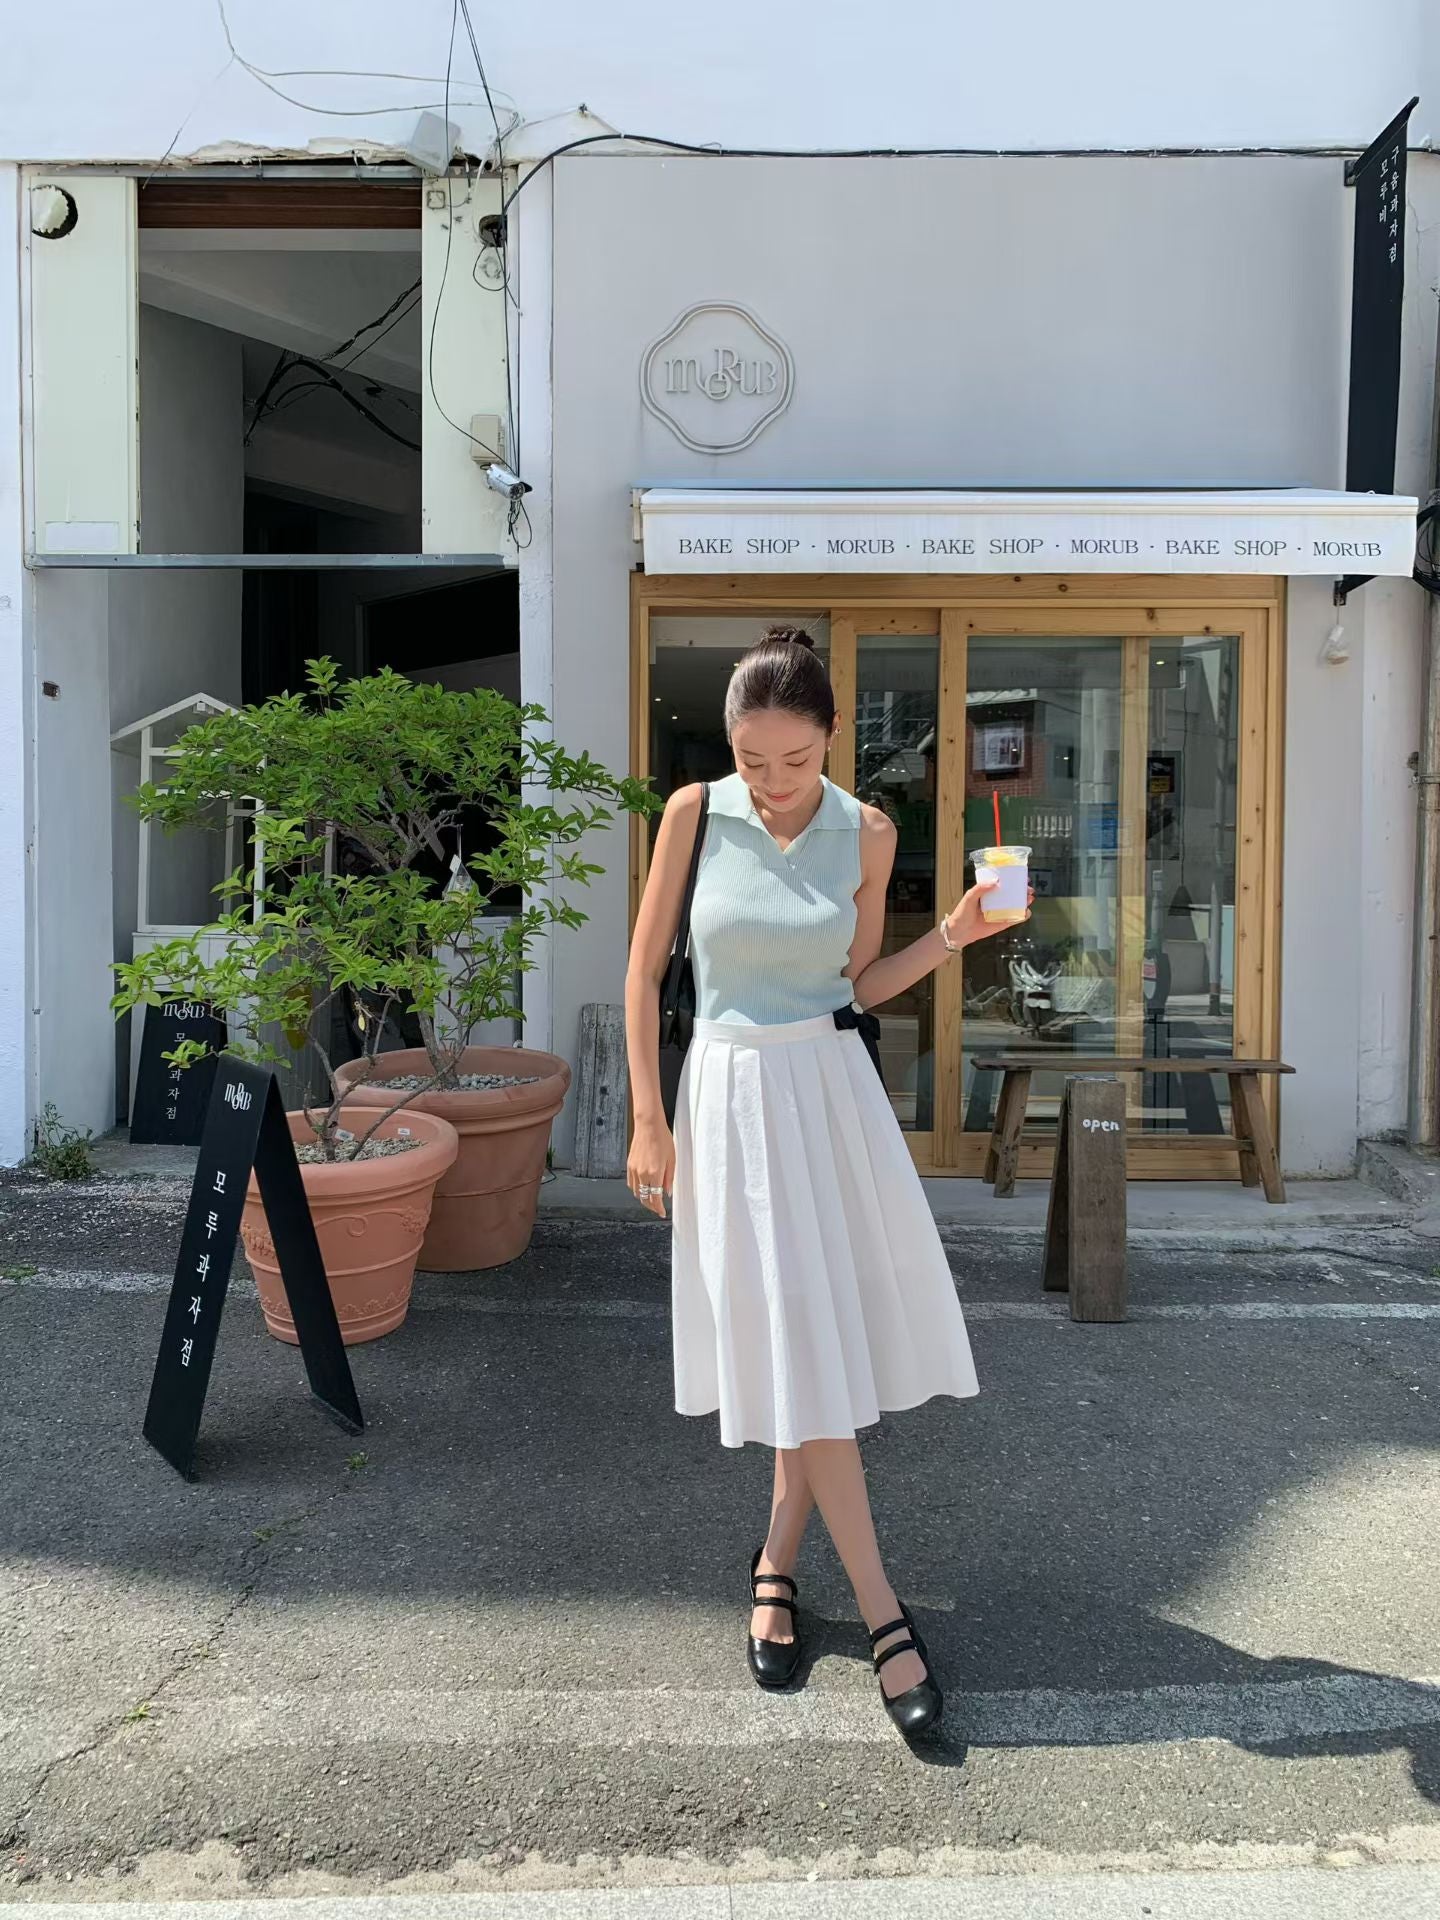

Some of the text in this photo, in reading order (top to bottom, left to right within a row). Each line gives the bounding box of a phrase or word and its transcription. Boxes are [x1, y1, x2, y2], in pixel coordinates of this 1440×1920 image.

[1388, 145, 1400, 264] 구움과자점
[679, 538, 1382, 557] BAKE SHOP MORUB BAKE SHOP MORUB BAKE SHOP MORUB
[165, 1031, 187, 1120] 모과자점
[1082, 1118, 1120, 1133] open
[180, 1170, 227, 1368] 모루과자점
